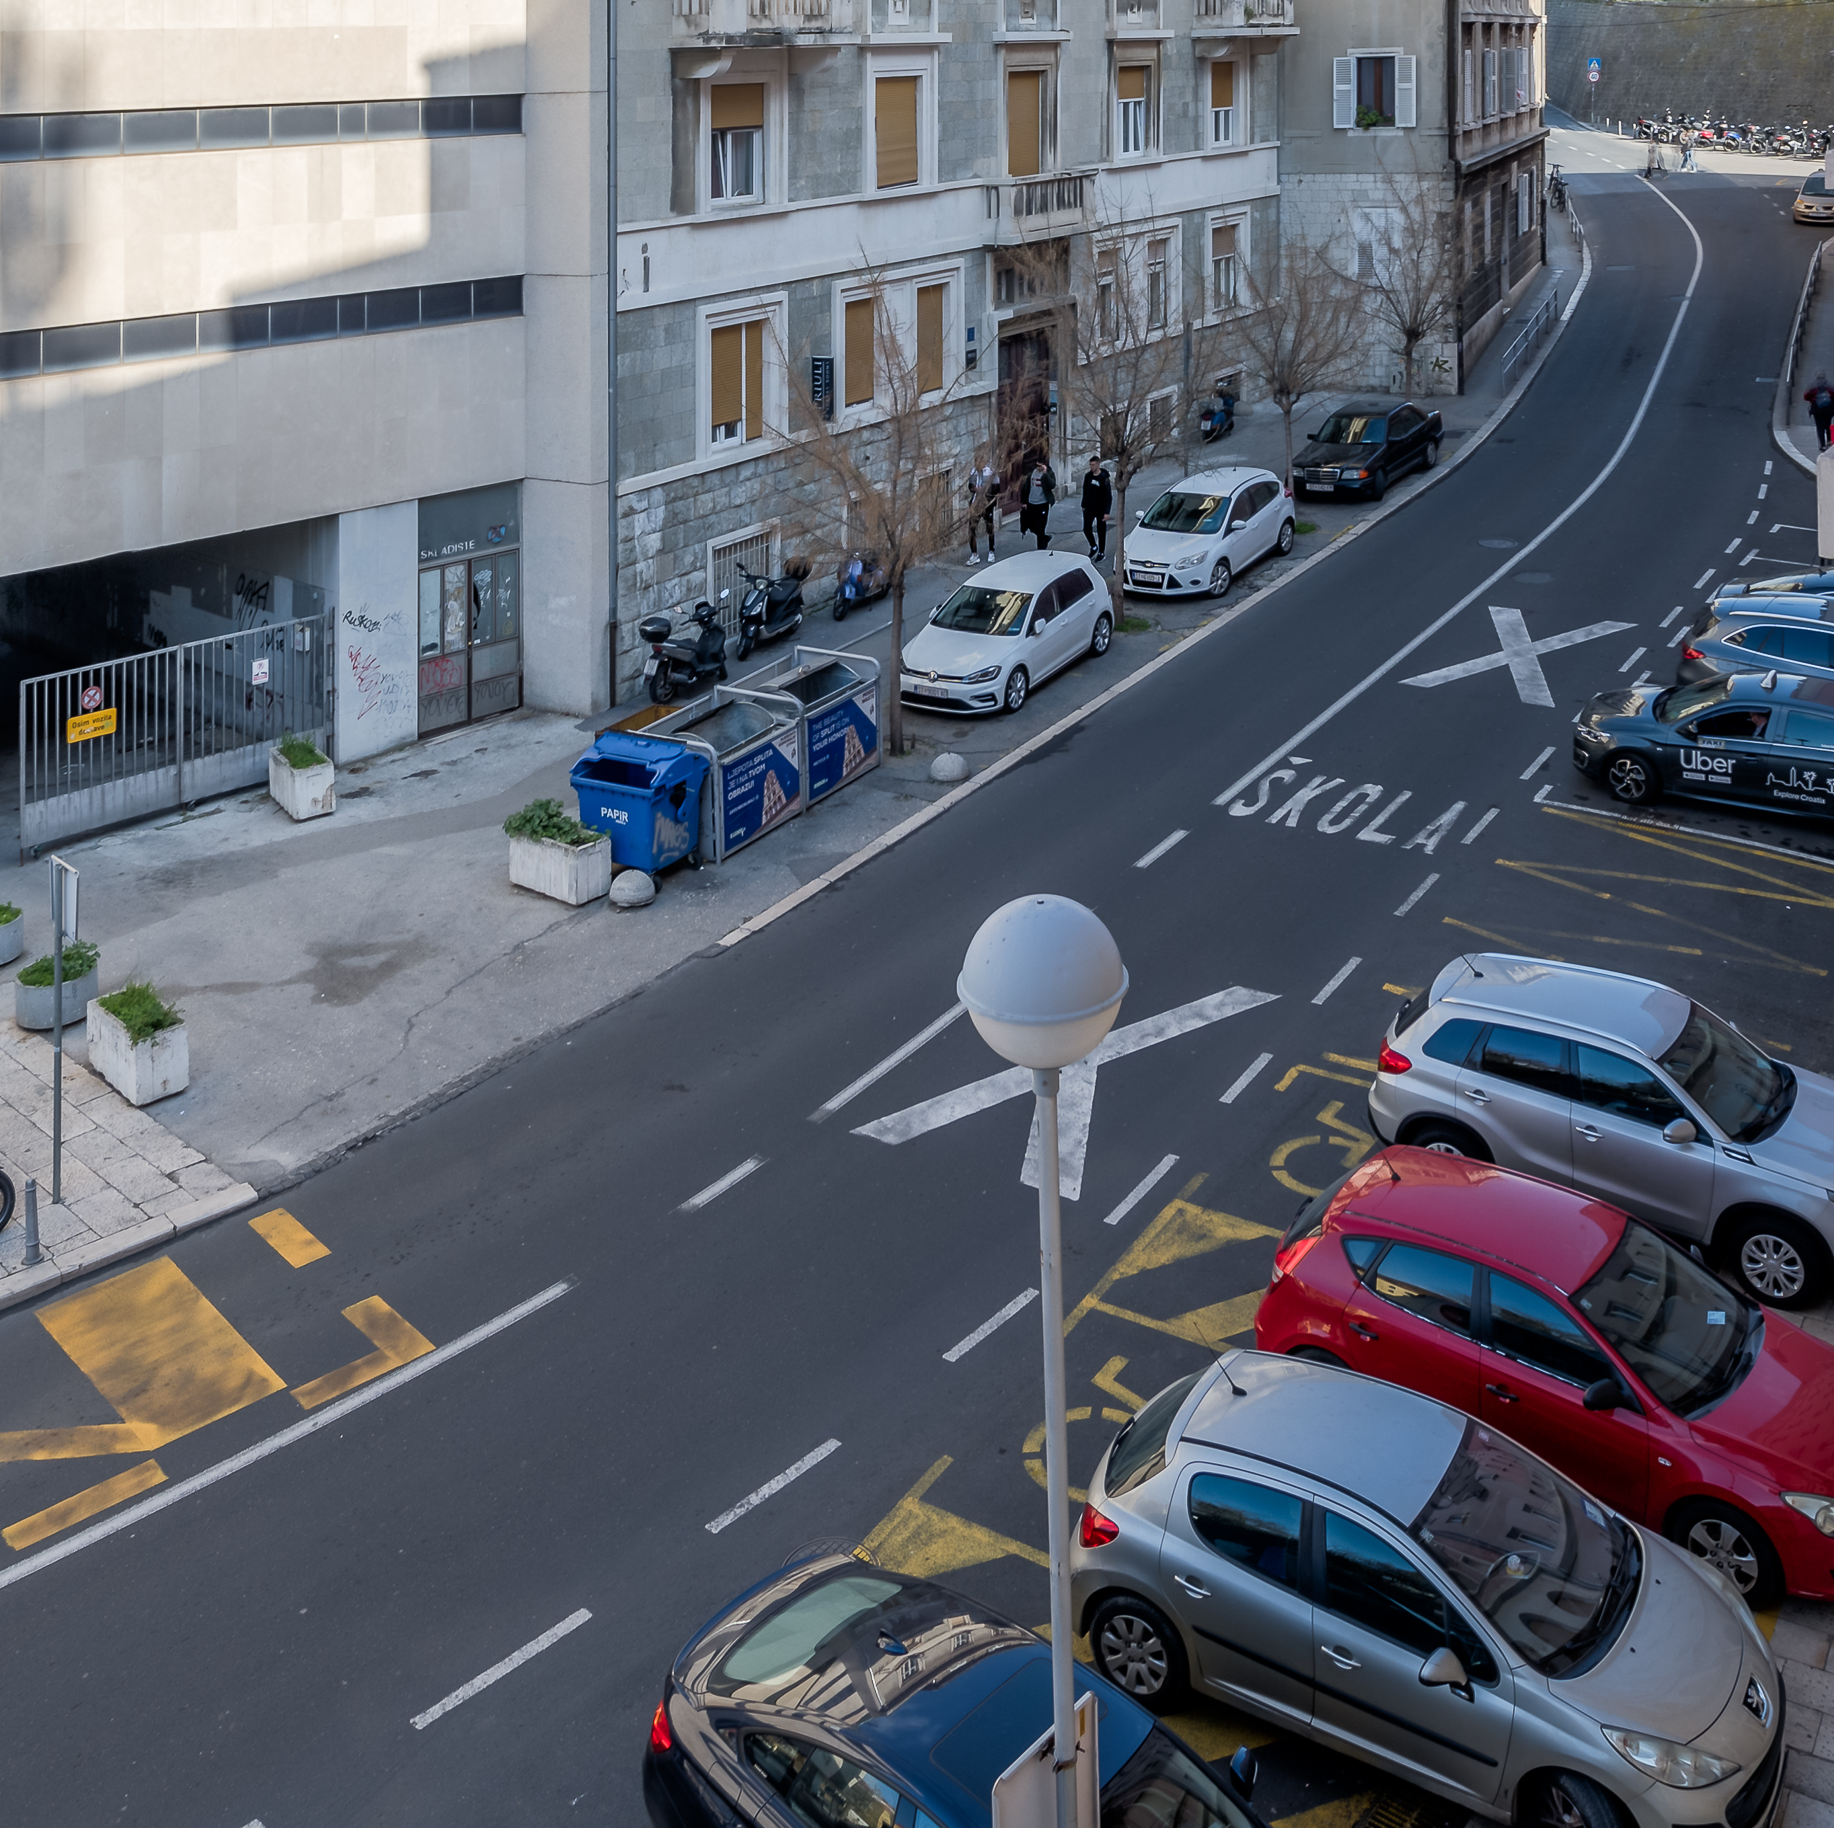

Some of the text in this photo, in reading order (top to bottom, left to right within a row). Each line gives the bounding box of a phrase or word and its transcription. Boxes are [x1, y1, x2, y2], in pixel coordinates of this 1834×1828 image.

[813, 361, 822, 408] RIULI
[72, 714, 112, 729] Osim vozila
[812, 710, 844, 732] THE BEAUTY
[812, 733, 820, 743] OF
[820, 724, 836, 738] SPLIT
[841, 716, 850, 727] ON
[812, 737, 828, 751] YOUR
[1700, 739, 1724, 749] TAXI
[727, 748, 773, 780] LJEPOTA SPLITA
[1680, 748, 1736, 773] Uber
[727, 779, 736, 790] JE
[739, 774, 749, 784] NA
[748, 763, 766, 779] TVOM
[1228, 756, 1467, 855] ŠKOLA
[1773, 789, 1826, 804] Explore Croatia
[600, 806, 628, 823] PAPIR
